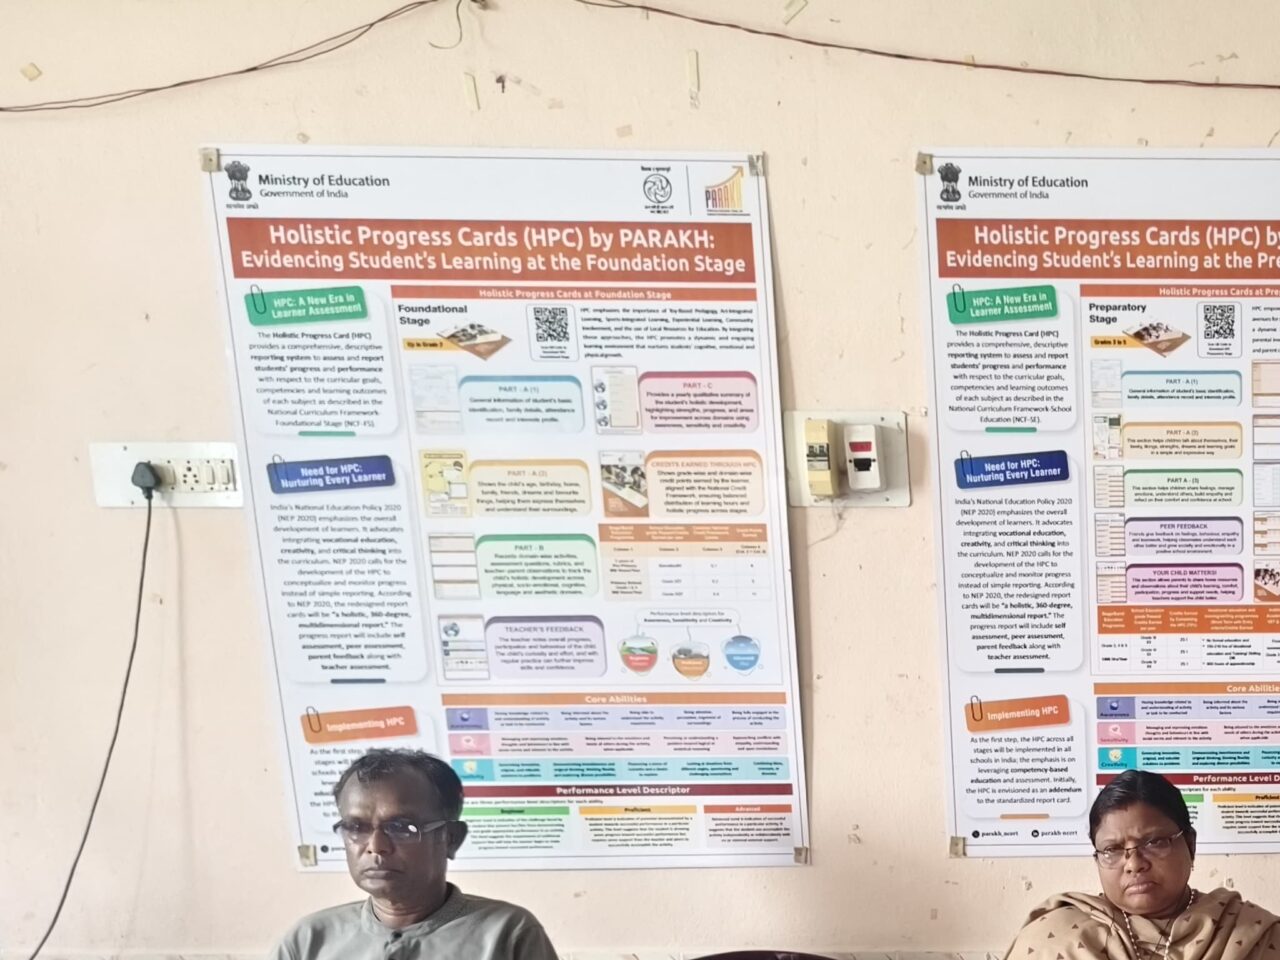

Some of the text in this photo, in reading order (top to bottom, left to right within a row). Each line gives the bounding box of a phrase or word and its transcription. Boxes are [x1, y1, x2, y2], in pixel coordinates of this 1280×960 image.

[258, 174, 390, 189] Ministry of Education
[968, 175, 1088, 190] Ministry of Education
[259, 189, 348, 197] Government of India
[967, 190, 1049, 198] Government of India
[269, 225, 714, 251] Holistic Progress Cards (HPC) by PARAKH:
[974, 225, 1049, 245] Holistic
[1054, 226, 1140, 250] Progress
[1145, 226, 1200, 245] Cards
[1205, 225, 1260, 249] (HPC)
[241, 250, 343, 272] Evidencing
[441, 252, 521, 274] Learning
[526, 253, 545, 270] at
[550, 253, 581, 270] the
[586, 253, 689, 271] Foundation
[693, 254, 745, 276] Stage
[946, 250, 1037, 271] Evidencing
[1126, 251, 1198, 272] Learning
[1203, 251, 1220, 268] at
[1225, 251, 1252, 268] the
[1157, 287, 1192, 295] Holistic
[1191, 287, 1229, 297] Progress
[1228, 287, 1254, 295] Cards
[1254, 287, 1265, 295] at
[273, 298, 296, 307] HPC:
[306, 296, 326, 305] New
[327, 294, 344, 304] Era
[972, 297, 993, 306] HPC:
[1002, 295, 1021, 304] New
[1022, 293, 1037, 302] Era
[270, 303, 363, 317] Learner Assessment
[397, 304, 467, 313] Foundational
[969, 302, 1052, 317] Learner Assessment
[1088, 303, 1146, 313] Preparatory
[399, 316, 430, 327] Stage
[1089, 314, 1117, 325] Stage
[994, 330, 1022, 338] Progress
[1040, 329, 1059, 338] (HPC)
[946, 340, 974, 349] provides
[981, 340, 1032, 349] comprehensive,
[1033, 340, 1068, 349] descriptive
[947, 351, 978, 360] reporting
[979, 351, 1002, 360] system
[1047, 351, 1068, 360] report
[300, 464, 362, 476] Need for HPC:
[984, 459, 1040, 471] Need for HPC:
[280, 474, 386, 488] Nurturing Every Learner
[966, 469, 1060, 482] Nurturing Every Learner
[1226, 684, 1246, 692] Core
[987, 705, 1058, 720] Implementing HPC
[326, 716, 404, 731] Implementing HPC
[555, 786, 690, 795] Performance Level Descriptor
